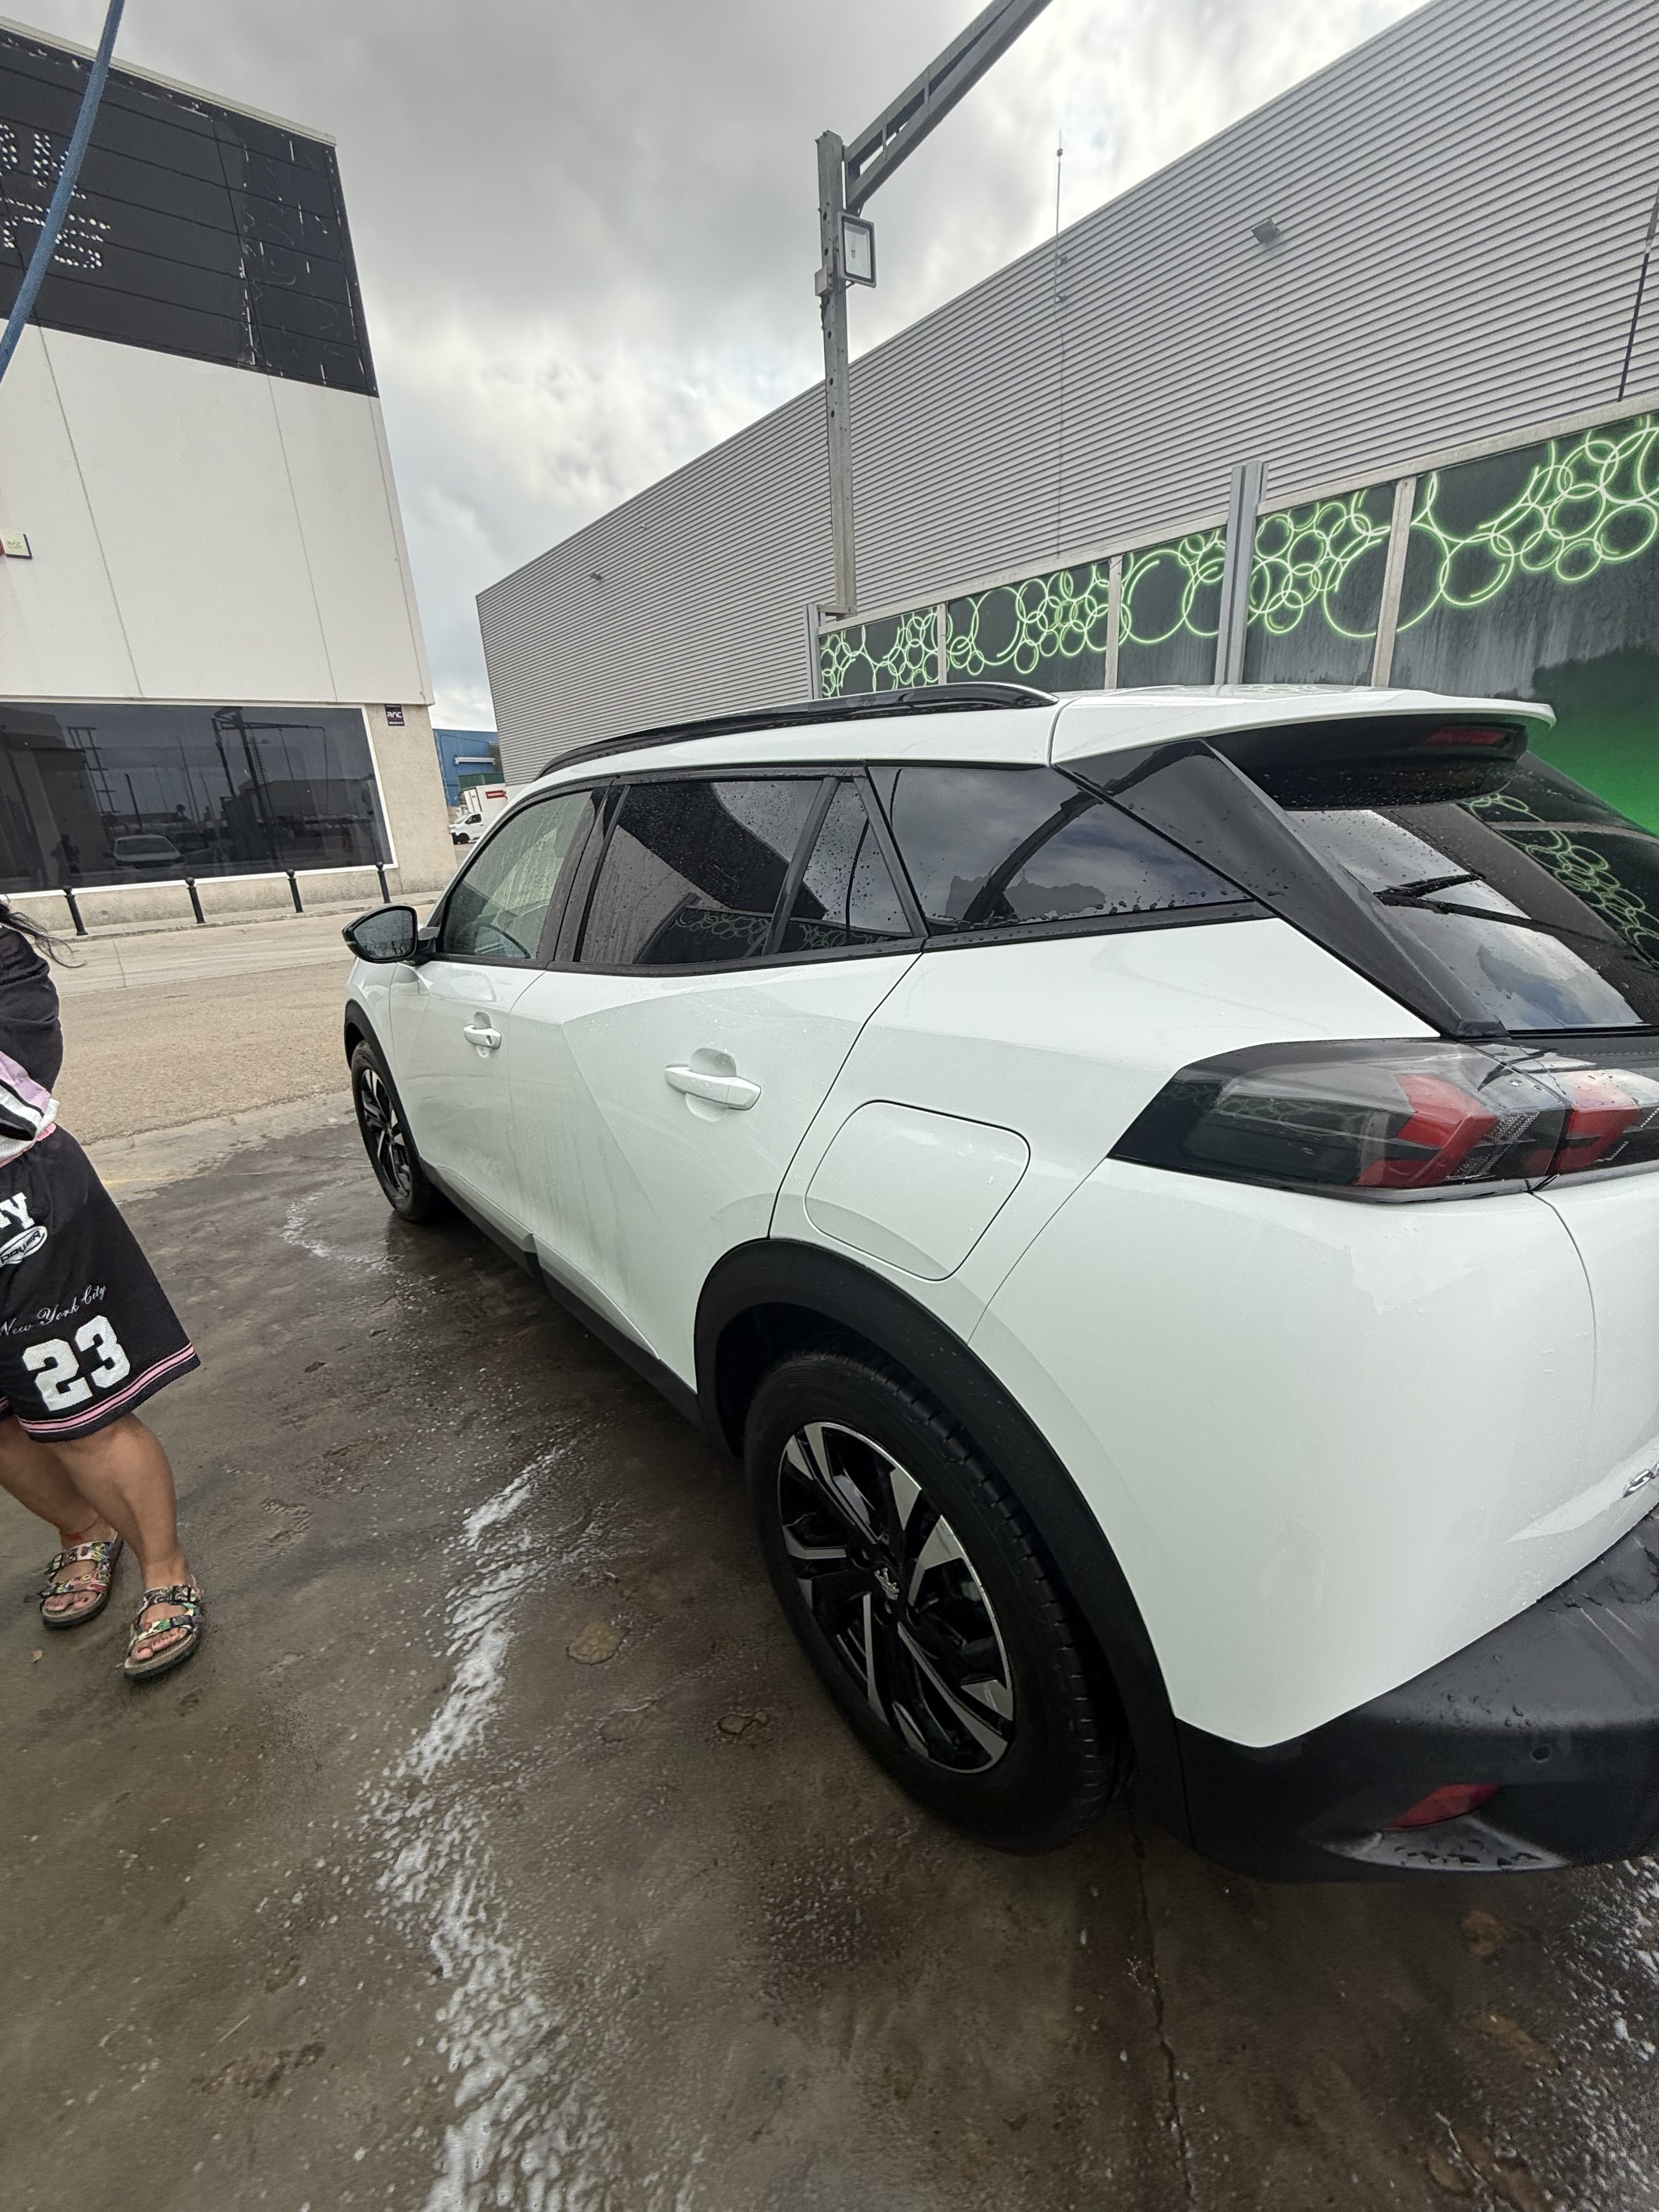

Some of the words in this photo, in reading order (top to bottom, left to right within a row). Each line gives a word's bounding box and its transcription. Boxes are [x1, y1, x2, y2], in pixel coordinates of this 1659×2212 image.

[0, 1318, 33, 1337] New
[37, 1296, 80, 1326] York
[82, 1284, 108, 1305] City
[22, 1315, 131, 1412] 23
